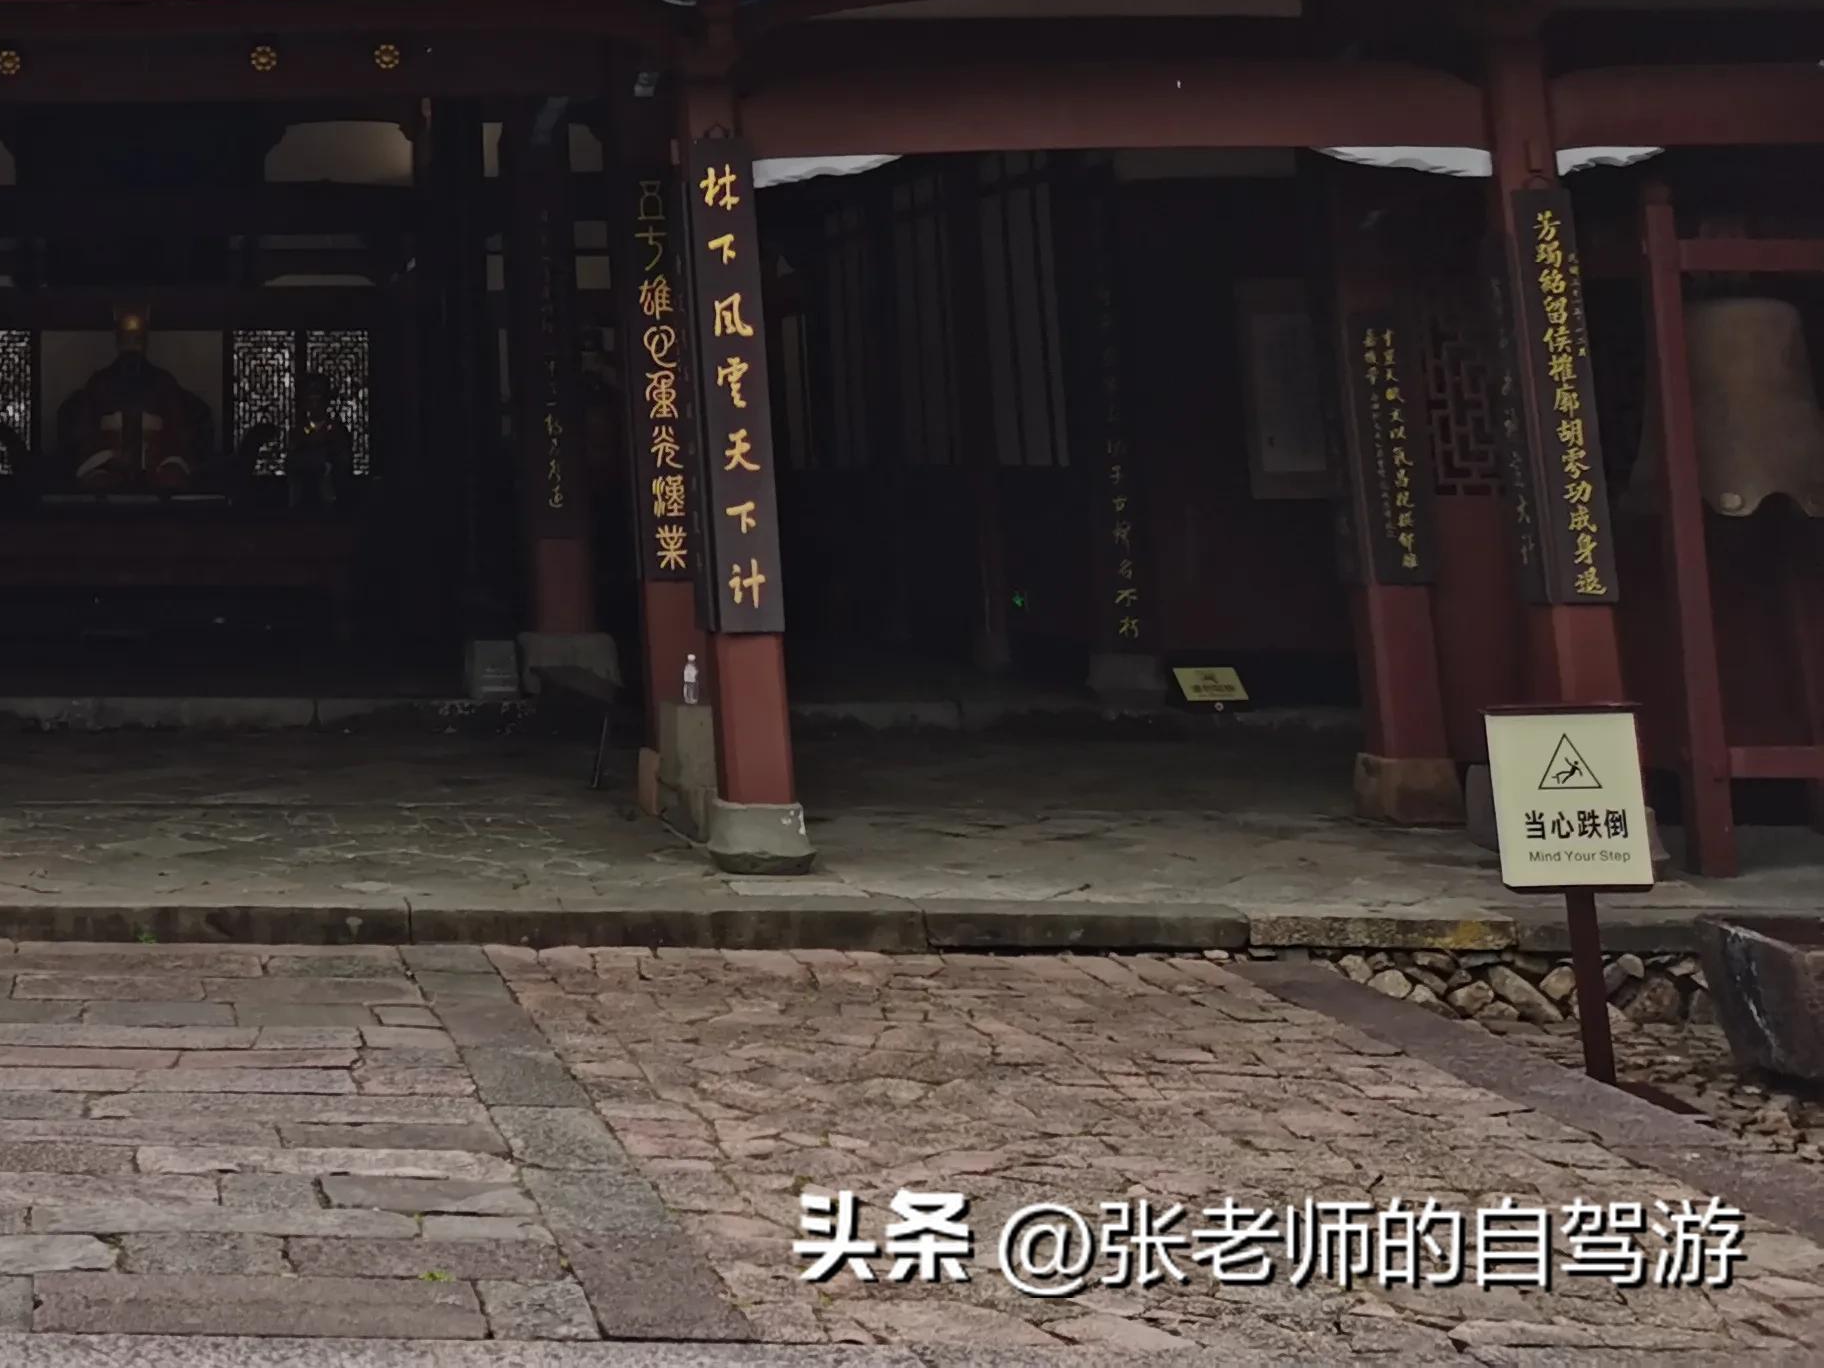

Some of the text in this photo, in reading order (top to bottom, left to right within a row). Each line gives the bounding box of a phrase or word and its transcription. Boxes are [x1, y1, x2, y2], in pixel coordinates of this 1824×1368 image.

[1524, 808, 1629, 841] 当心跌倒
[1529, 849, 1632, 864] Mind Your Step
